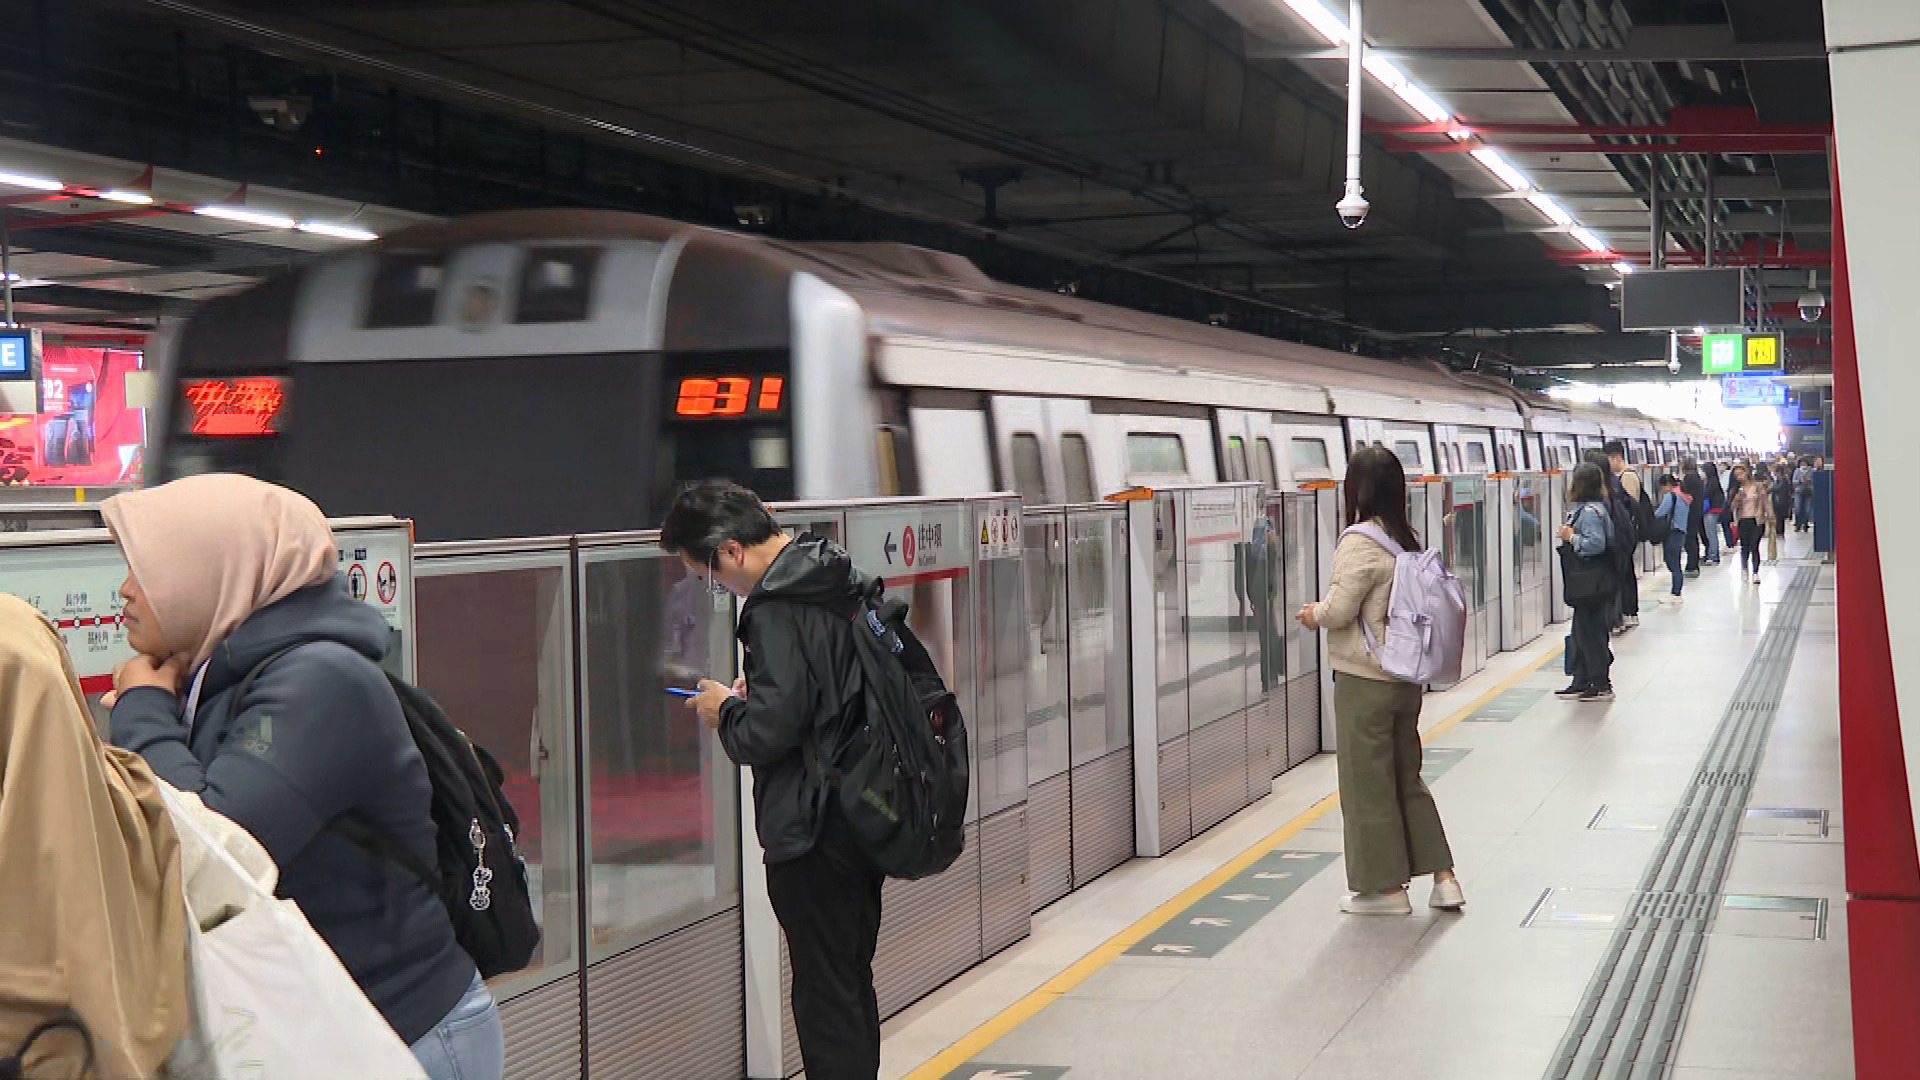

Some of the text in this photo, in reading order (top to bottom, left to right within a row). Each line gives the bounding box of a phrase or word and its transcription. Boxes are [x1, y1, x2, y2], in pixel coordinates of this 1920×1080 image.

[1, 343, 16, 367] E
[918, 523, 942, 551] 往中環
